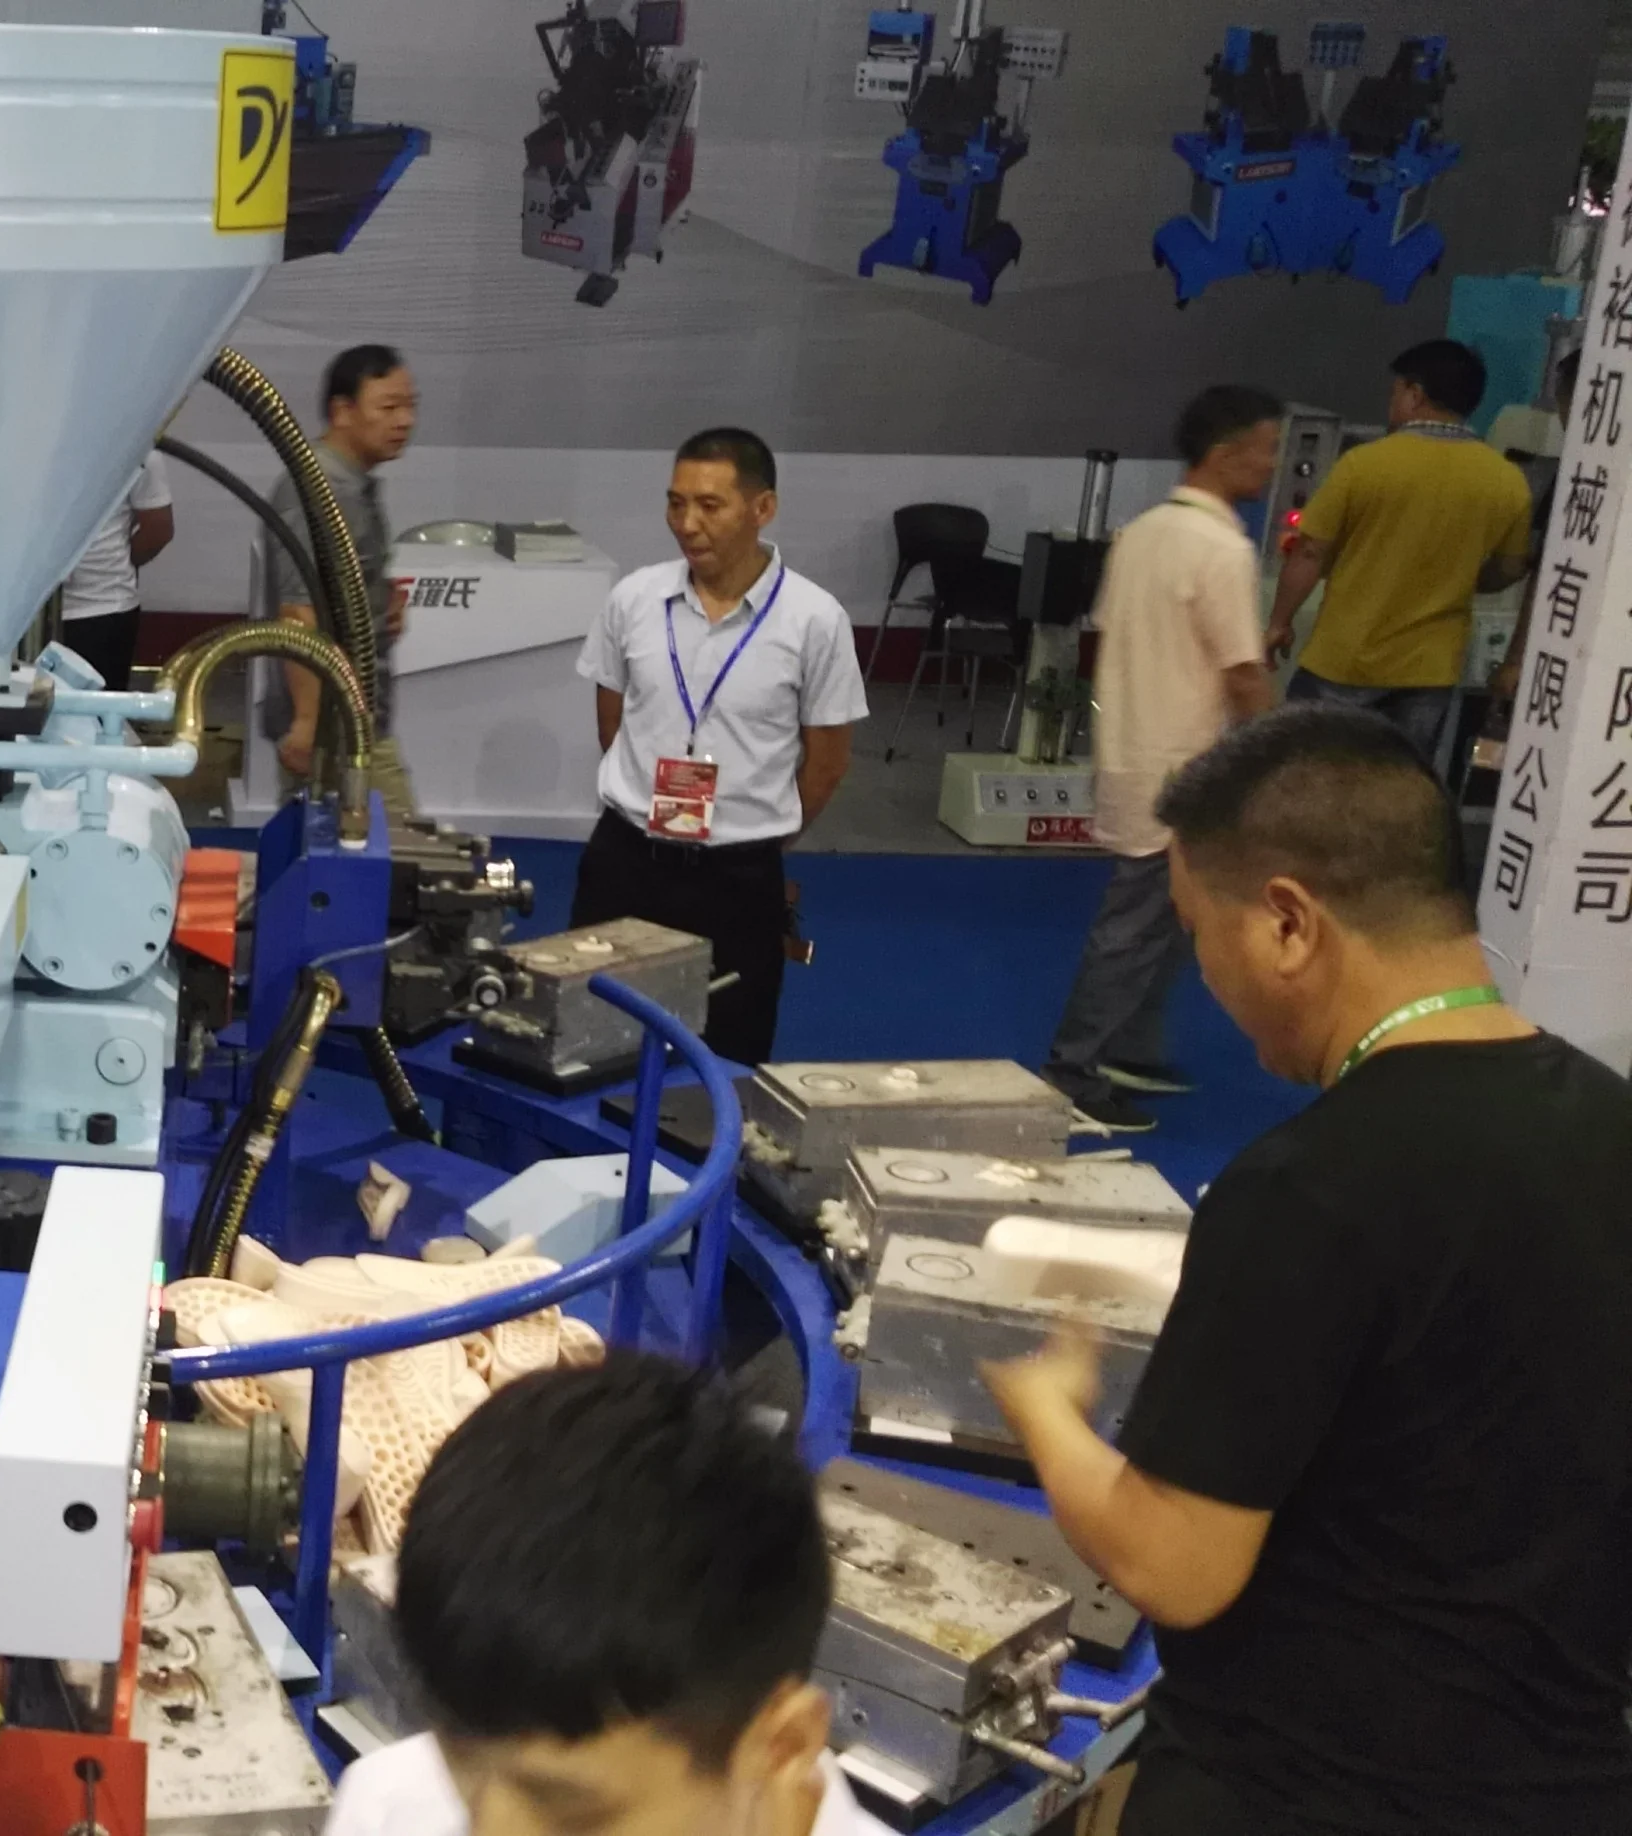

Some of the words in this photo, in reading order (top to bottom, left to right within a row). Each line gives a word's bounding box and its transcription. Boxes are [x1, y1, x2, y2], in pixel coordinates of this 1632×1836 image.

[1494, 184, 1632, 911] 裕机械有限公司
